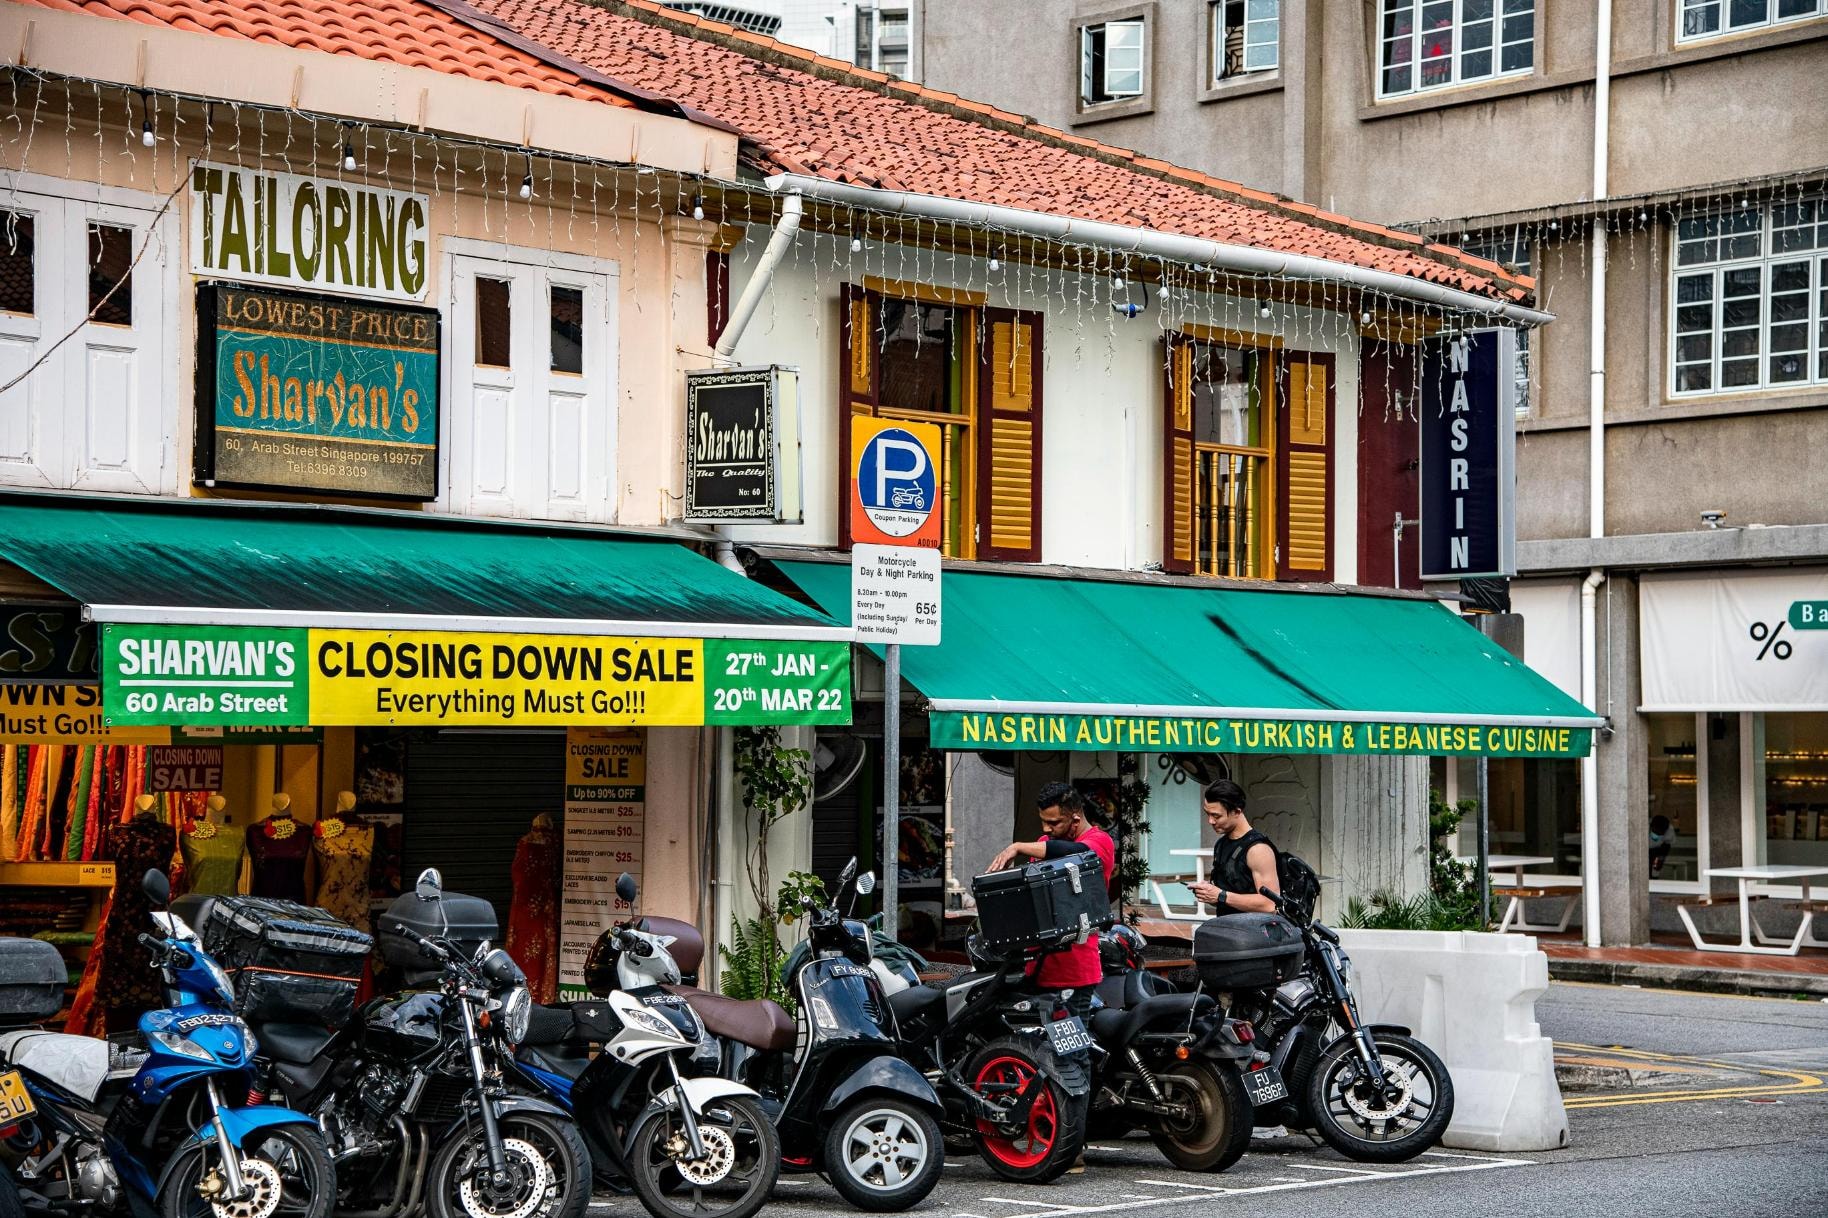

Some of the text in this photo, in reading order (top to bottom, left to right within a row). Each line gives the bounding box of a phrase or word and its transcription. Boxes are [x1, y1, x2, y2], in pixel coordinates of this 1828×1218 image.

[194, 167, 425, 294] TAILORING
[226, 295, 429, 340] LOWEST PRICE
[233, 351, 418, 433] Sharvan's
[698, 408, 764, 461] Sharvan's
[252, 443, 279, 454] Arab
[283, 443, 319, 457] Street
[321, 447, 380, 463] Singapore
[383, 452, 424, 466] 199757
[1450, 341, 1469, 568] NASRIN
[338, 466, 367, 477] 8309
[722, 469, 765, 478] Quality
[739, 488, 761, 496] No: 60
[874, 513, 920, 525] Coupon Parking
[878, 556, 917, 568] Motorcycle
[860, 566, 934, 582] Day & Night Parking
[885, 590, 908, 599] 10.00pm
[857, 601, 885, 610] Every Day
[857, 613, 885, 622] (Including
[927, 618, 938, 626] Day
[876, 627, 898, 635] Holiday)
[119, 639, 295, 676] SHARVAN'S
[318, 640, 694, 682] CLOSING DOWN SALE
[726, 652, 766, 675] 27th
[771, 653, 815, 676] JAN
[126, 692, 288, 713] 60 Arab Street
[377, 688, 645, 718] Everything Must Go!!!
[714, 687, 842, 711] 20th MAR 22
[0, 713, 47, 734] ust
[963, 716, 1570, 752] NASRIN AUTHENTIC TURKISH & LEBANESE CUISINE
[154, 749, 221, 765] CLOSING DOWN
[571, 744, 642, 755] CLOSING DOWN
[582, 757, 629, 778] SALE
[154, 767, 220, 790] SALE
[574, 788, 636, 799] Up to 90% OFF
[617, 806, 633, 817] $25
[617, 826, 632, 837] $10
[616, 851, 632, 863] $25
[1254, 1071, 1270, 1087] FU
[1252, 1082, 1282, 1103] 7696P
